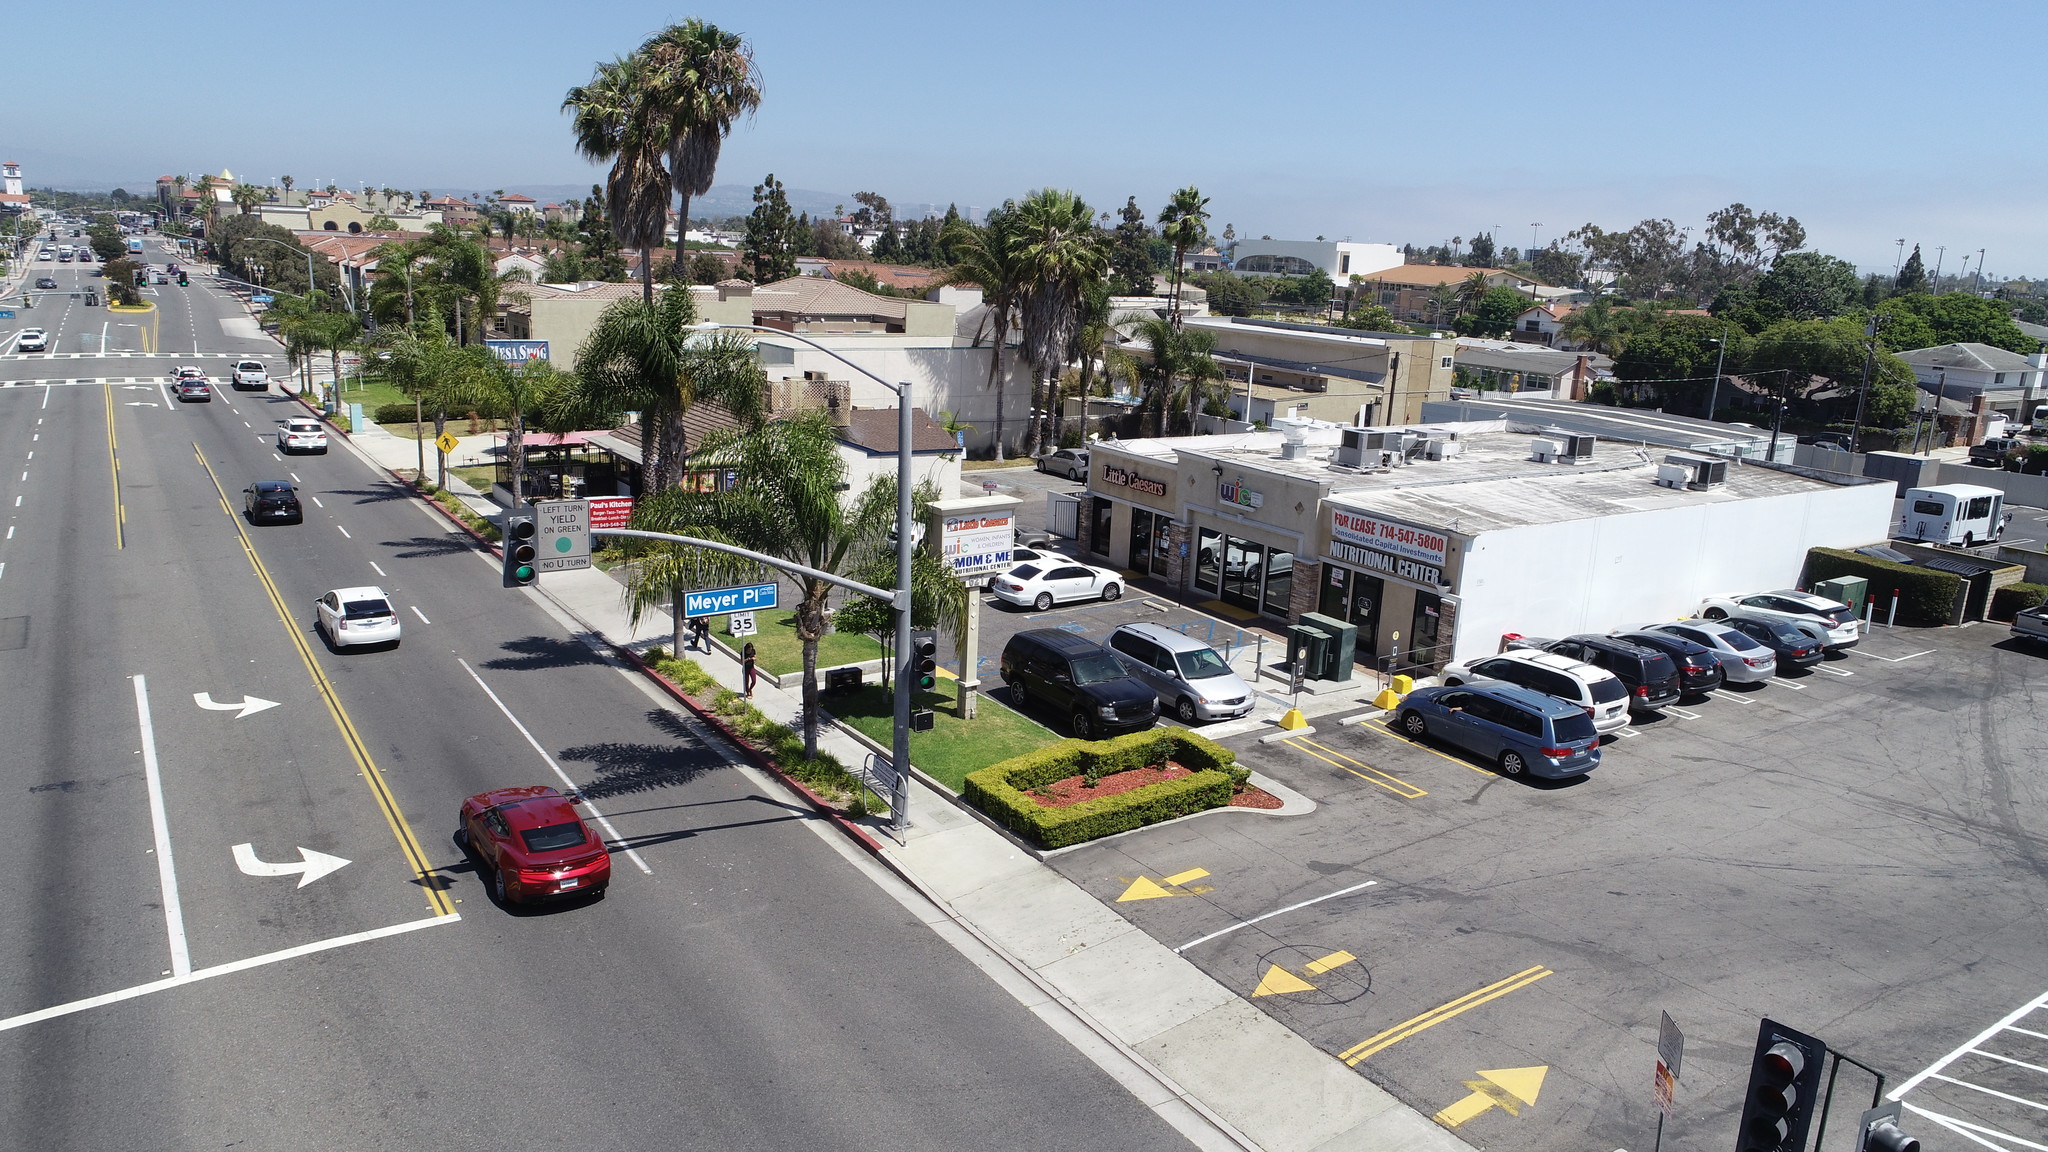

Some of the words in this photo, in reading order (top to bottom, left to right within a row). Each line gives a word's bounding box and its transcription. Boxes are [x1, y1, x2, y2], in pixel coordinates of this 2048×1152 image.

[490, 345, 518, 360] MESA
[520, 345, 547, 360] SMOG
[1103, 464, 1126, 486] Little
[1128, 472, 1164, 496] Caesars
[543, 505, 560, 514] LEFT
[564, 504, 583, 512] TURN
[550, 514, 576, 524] YIELD
[557, 525, 582, 533] GREEN
[1334, 511, 1349, 528] FOR
[1350, 517, 1376, 535] LEASE
[1379, 523, 1444, 553] 714-547-5800
[992, 533, 1011, 541] INFANTS
[982, 541, 1005, 549] CHILDREN
[1335, 527, 1374, 545] Consolidated
[1374, 539, 1399, 552] Capital
[1400, 545, 1442, 563] Investments
[543, 561, 554, 569] NO
[557, 558, 564, 567] U
[567, 558, 586, 566] TURN
[955, 555, 983, 568] MOM
[985, 554, 992, 564] &
[995, 551, 1011, 562] ME
[1329, 540, 1395, 573] NUTRITIONAL
[1397, 559, 1440, 584] CENTER
[990, 562, 1011, 570] CENTER
[688, 593, 738, 611] Meyer
[743, 588, 759, 604] Pl
[733, 618, 752, 630] 35
